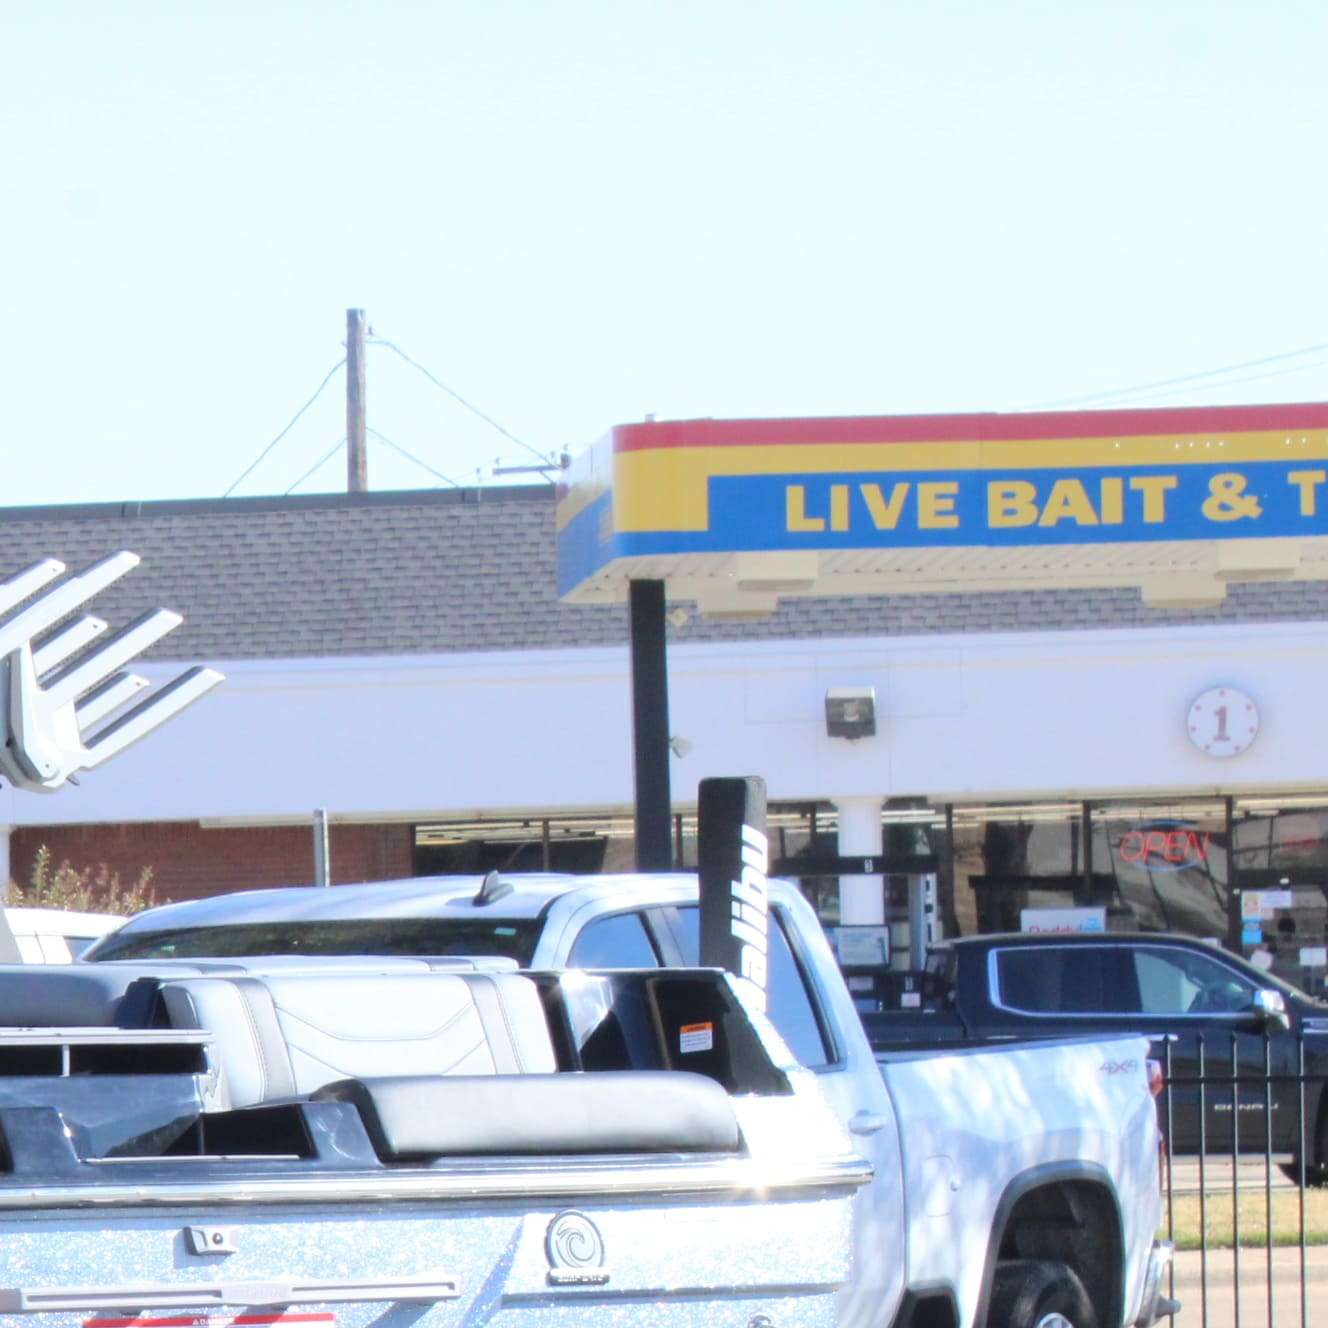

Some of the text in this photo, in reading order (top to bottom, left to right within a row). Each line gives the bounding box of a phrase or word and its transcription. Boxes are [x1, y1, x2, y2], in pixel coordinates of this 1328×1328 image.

[785, 470, 1327, 532] LIVE BAIT & T
[1213, 705, 1231, 742] 1
[1118, 830, 1212, 863] OPEN
